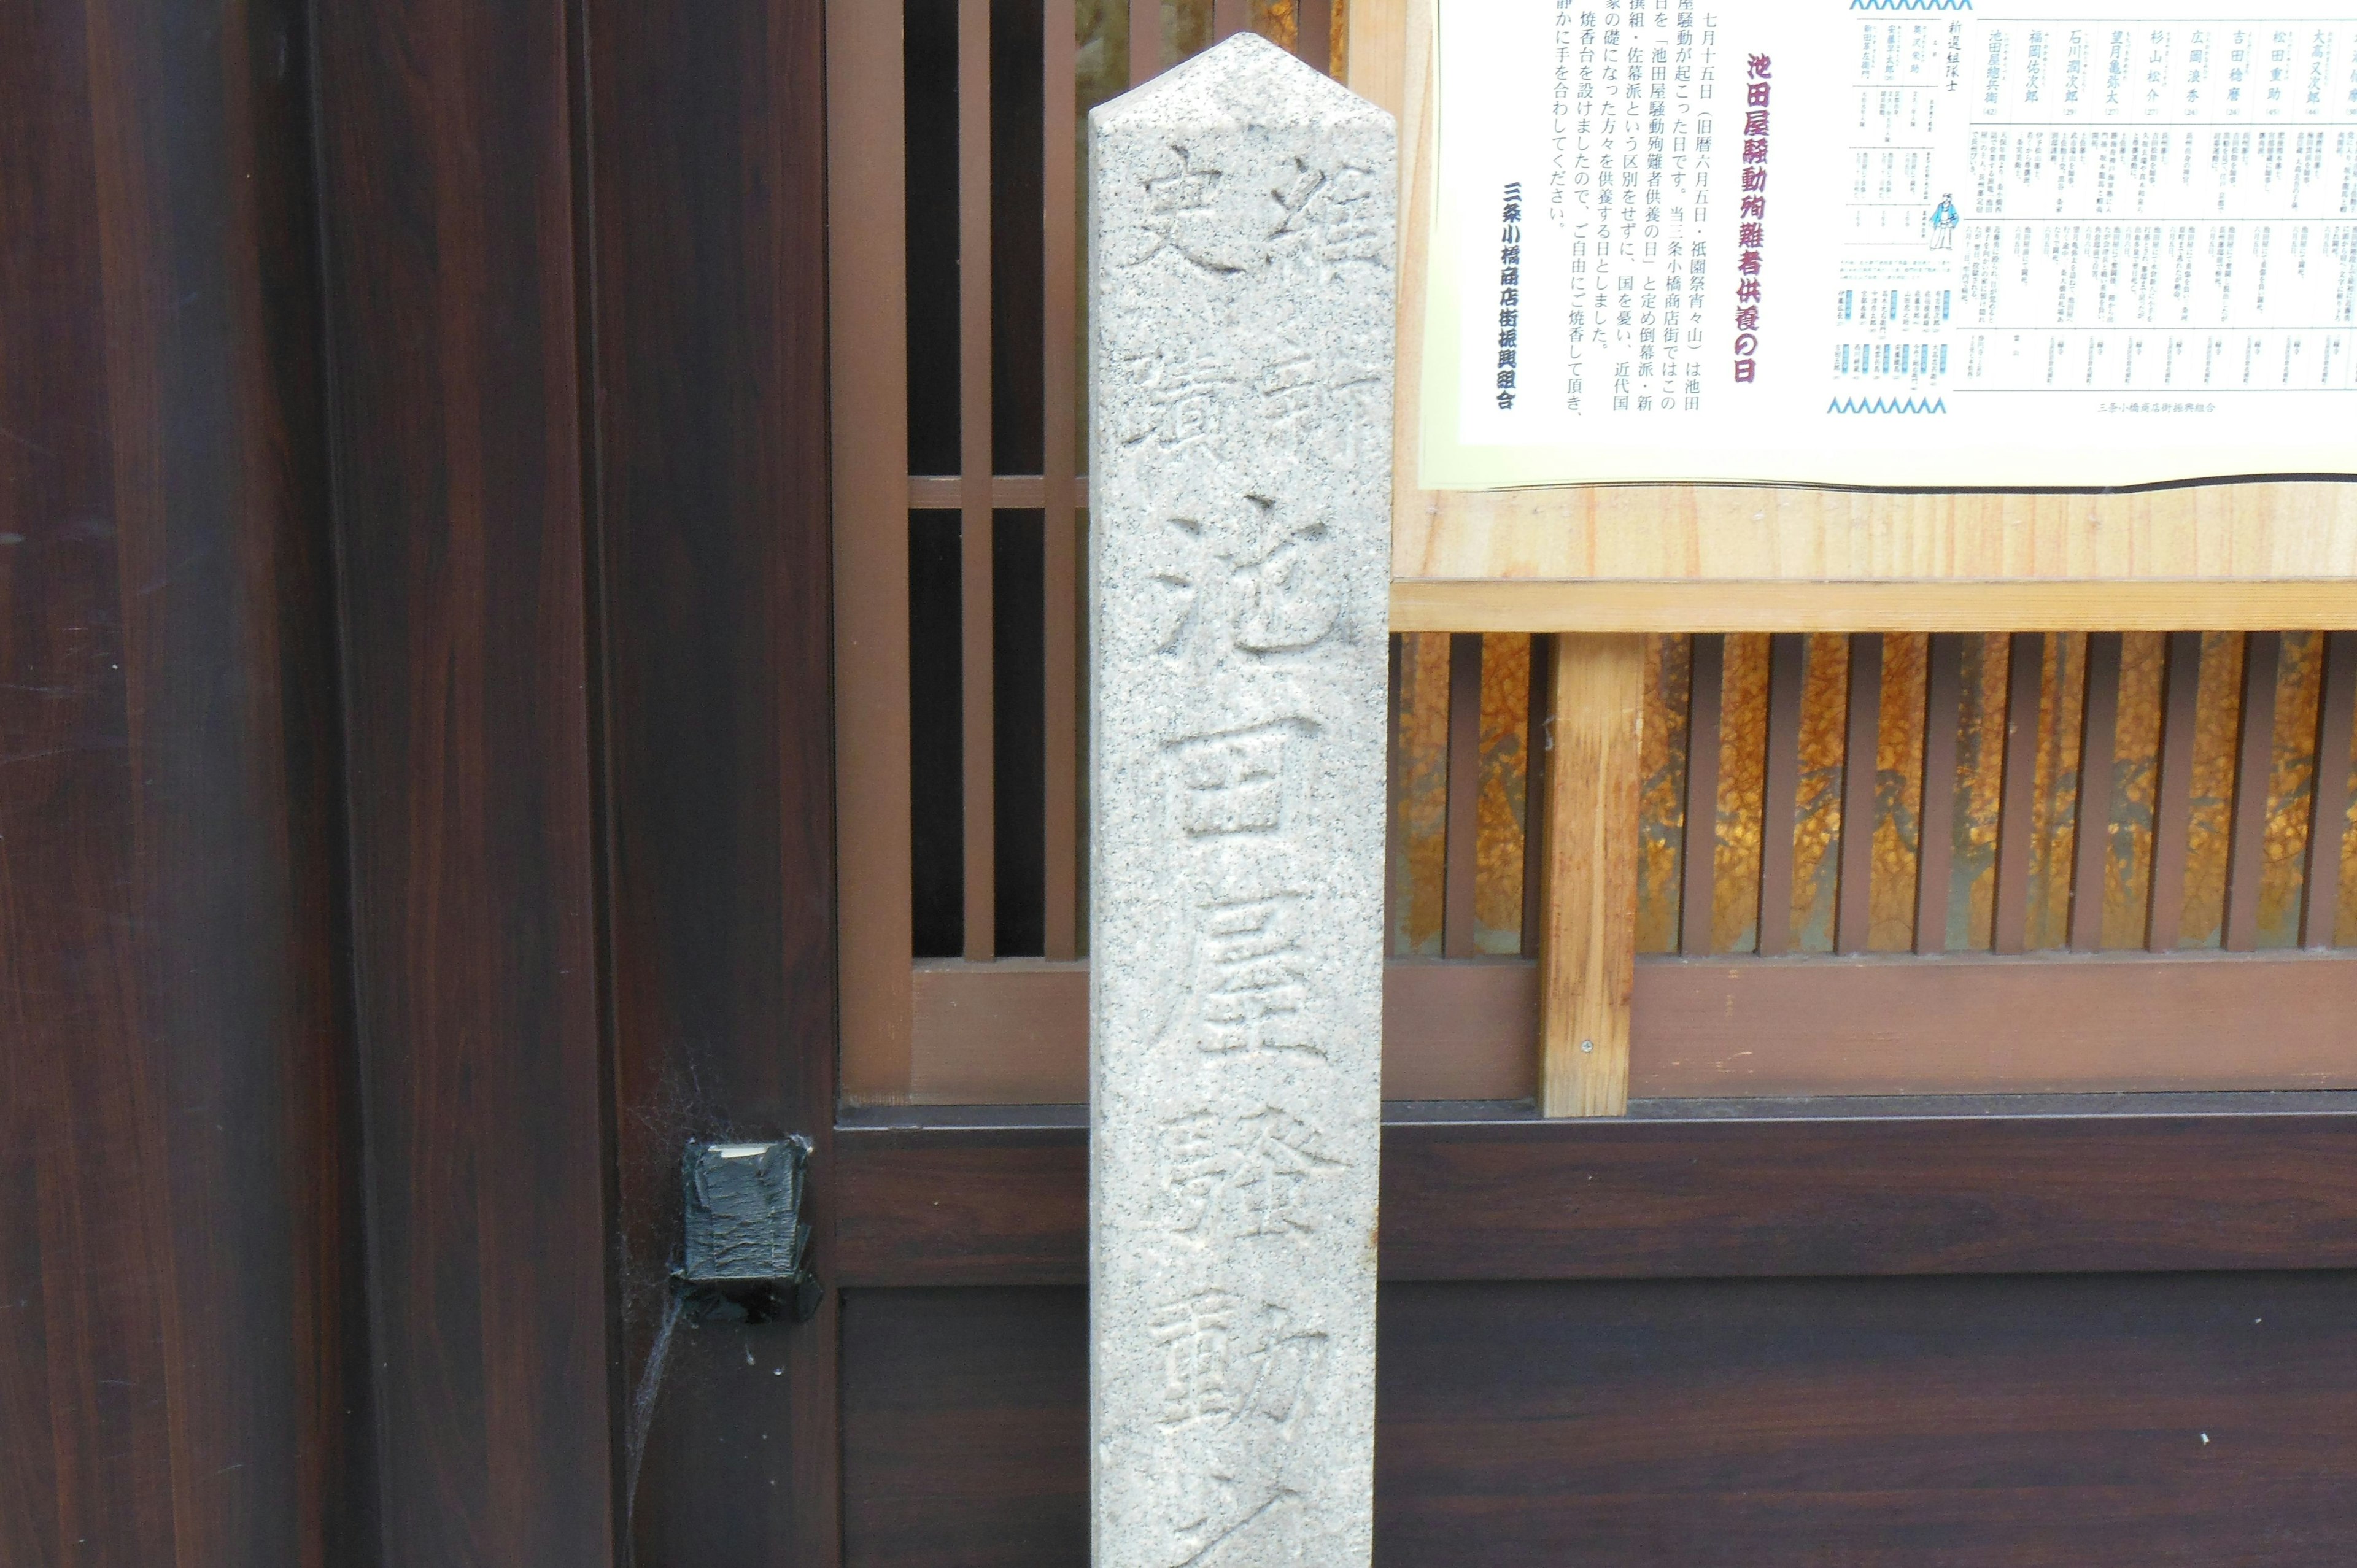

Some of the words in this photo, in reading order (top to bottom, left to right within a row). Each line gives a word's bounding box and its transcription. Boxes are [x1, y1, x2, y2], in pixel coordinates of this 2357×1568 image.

[1946, 20, 1962, 91] 新選組隊士
[1496, 182, 1522, 410] 三条小橋商店街振興組合
[1733, 52, 1773, 384] 池田屋騒動殉難者供養の日
